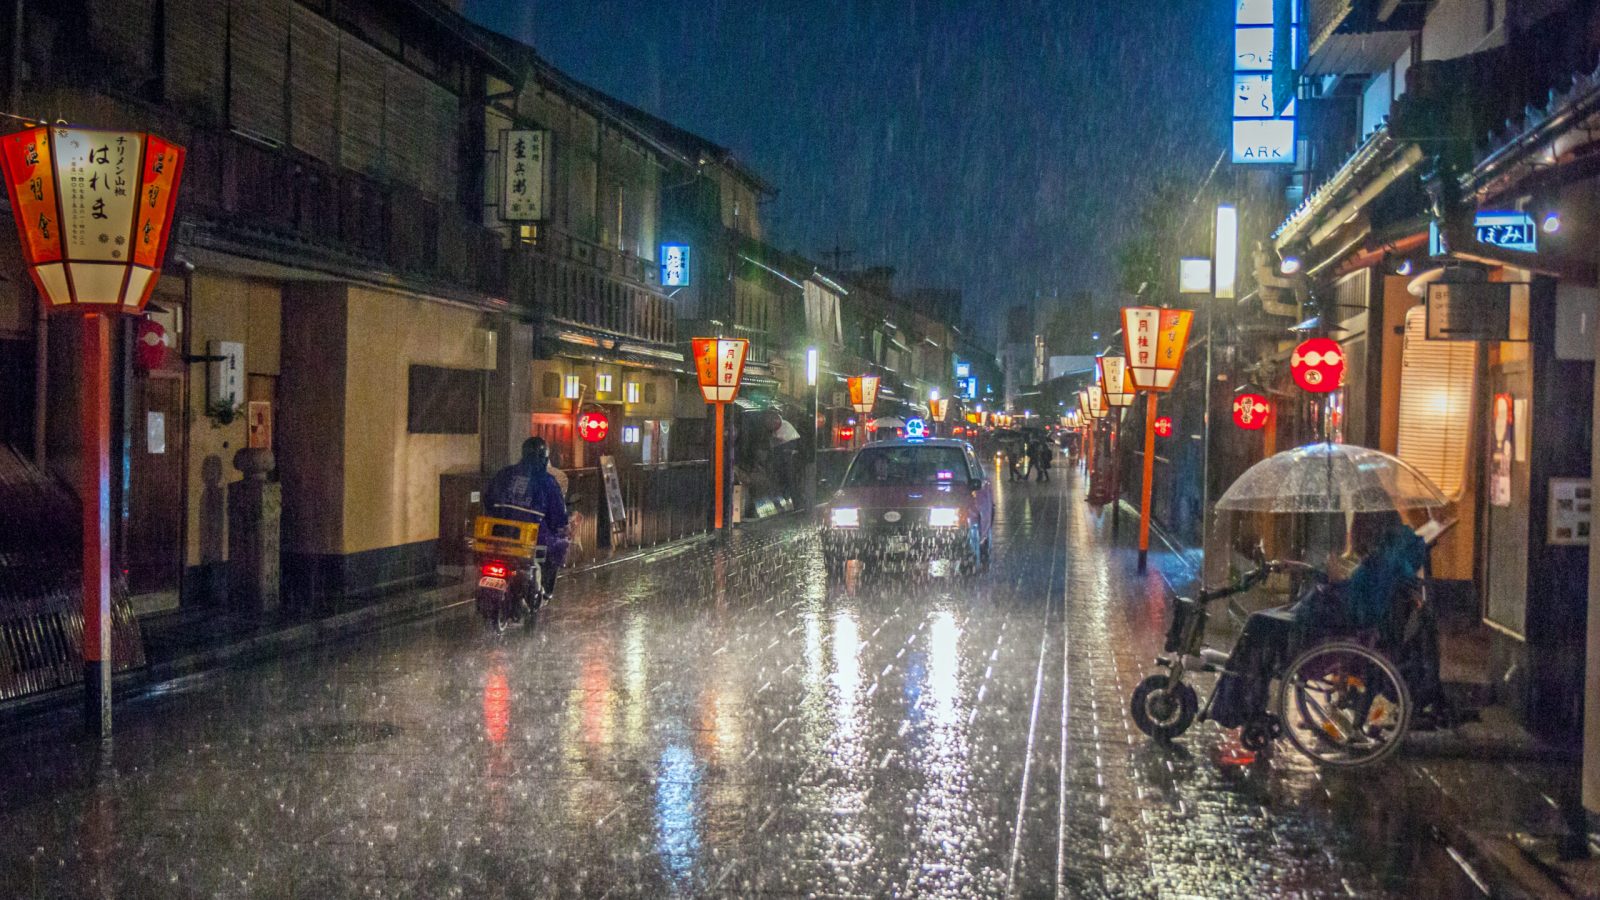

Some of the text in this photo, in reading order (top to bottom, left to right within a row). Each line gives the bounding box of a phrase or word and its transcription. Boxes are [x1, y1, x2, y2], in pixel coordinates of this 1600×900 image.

[1243, 146, 1281, 157] ARK
[89, 144, 111, 220] はれま
